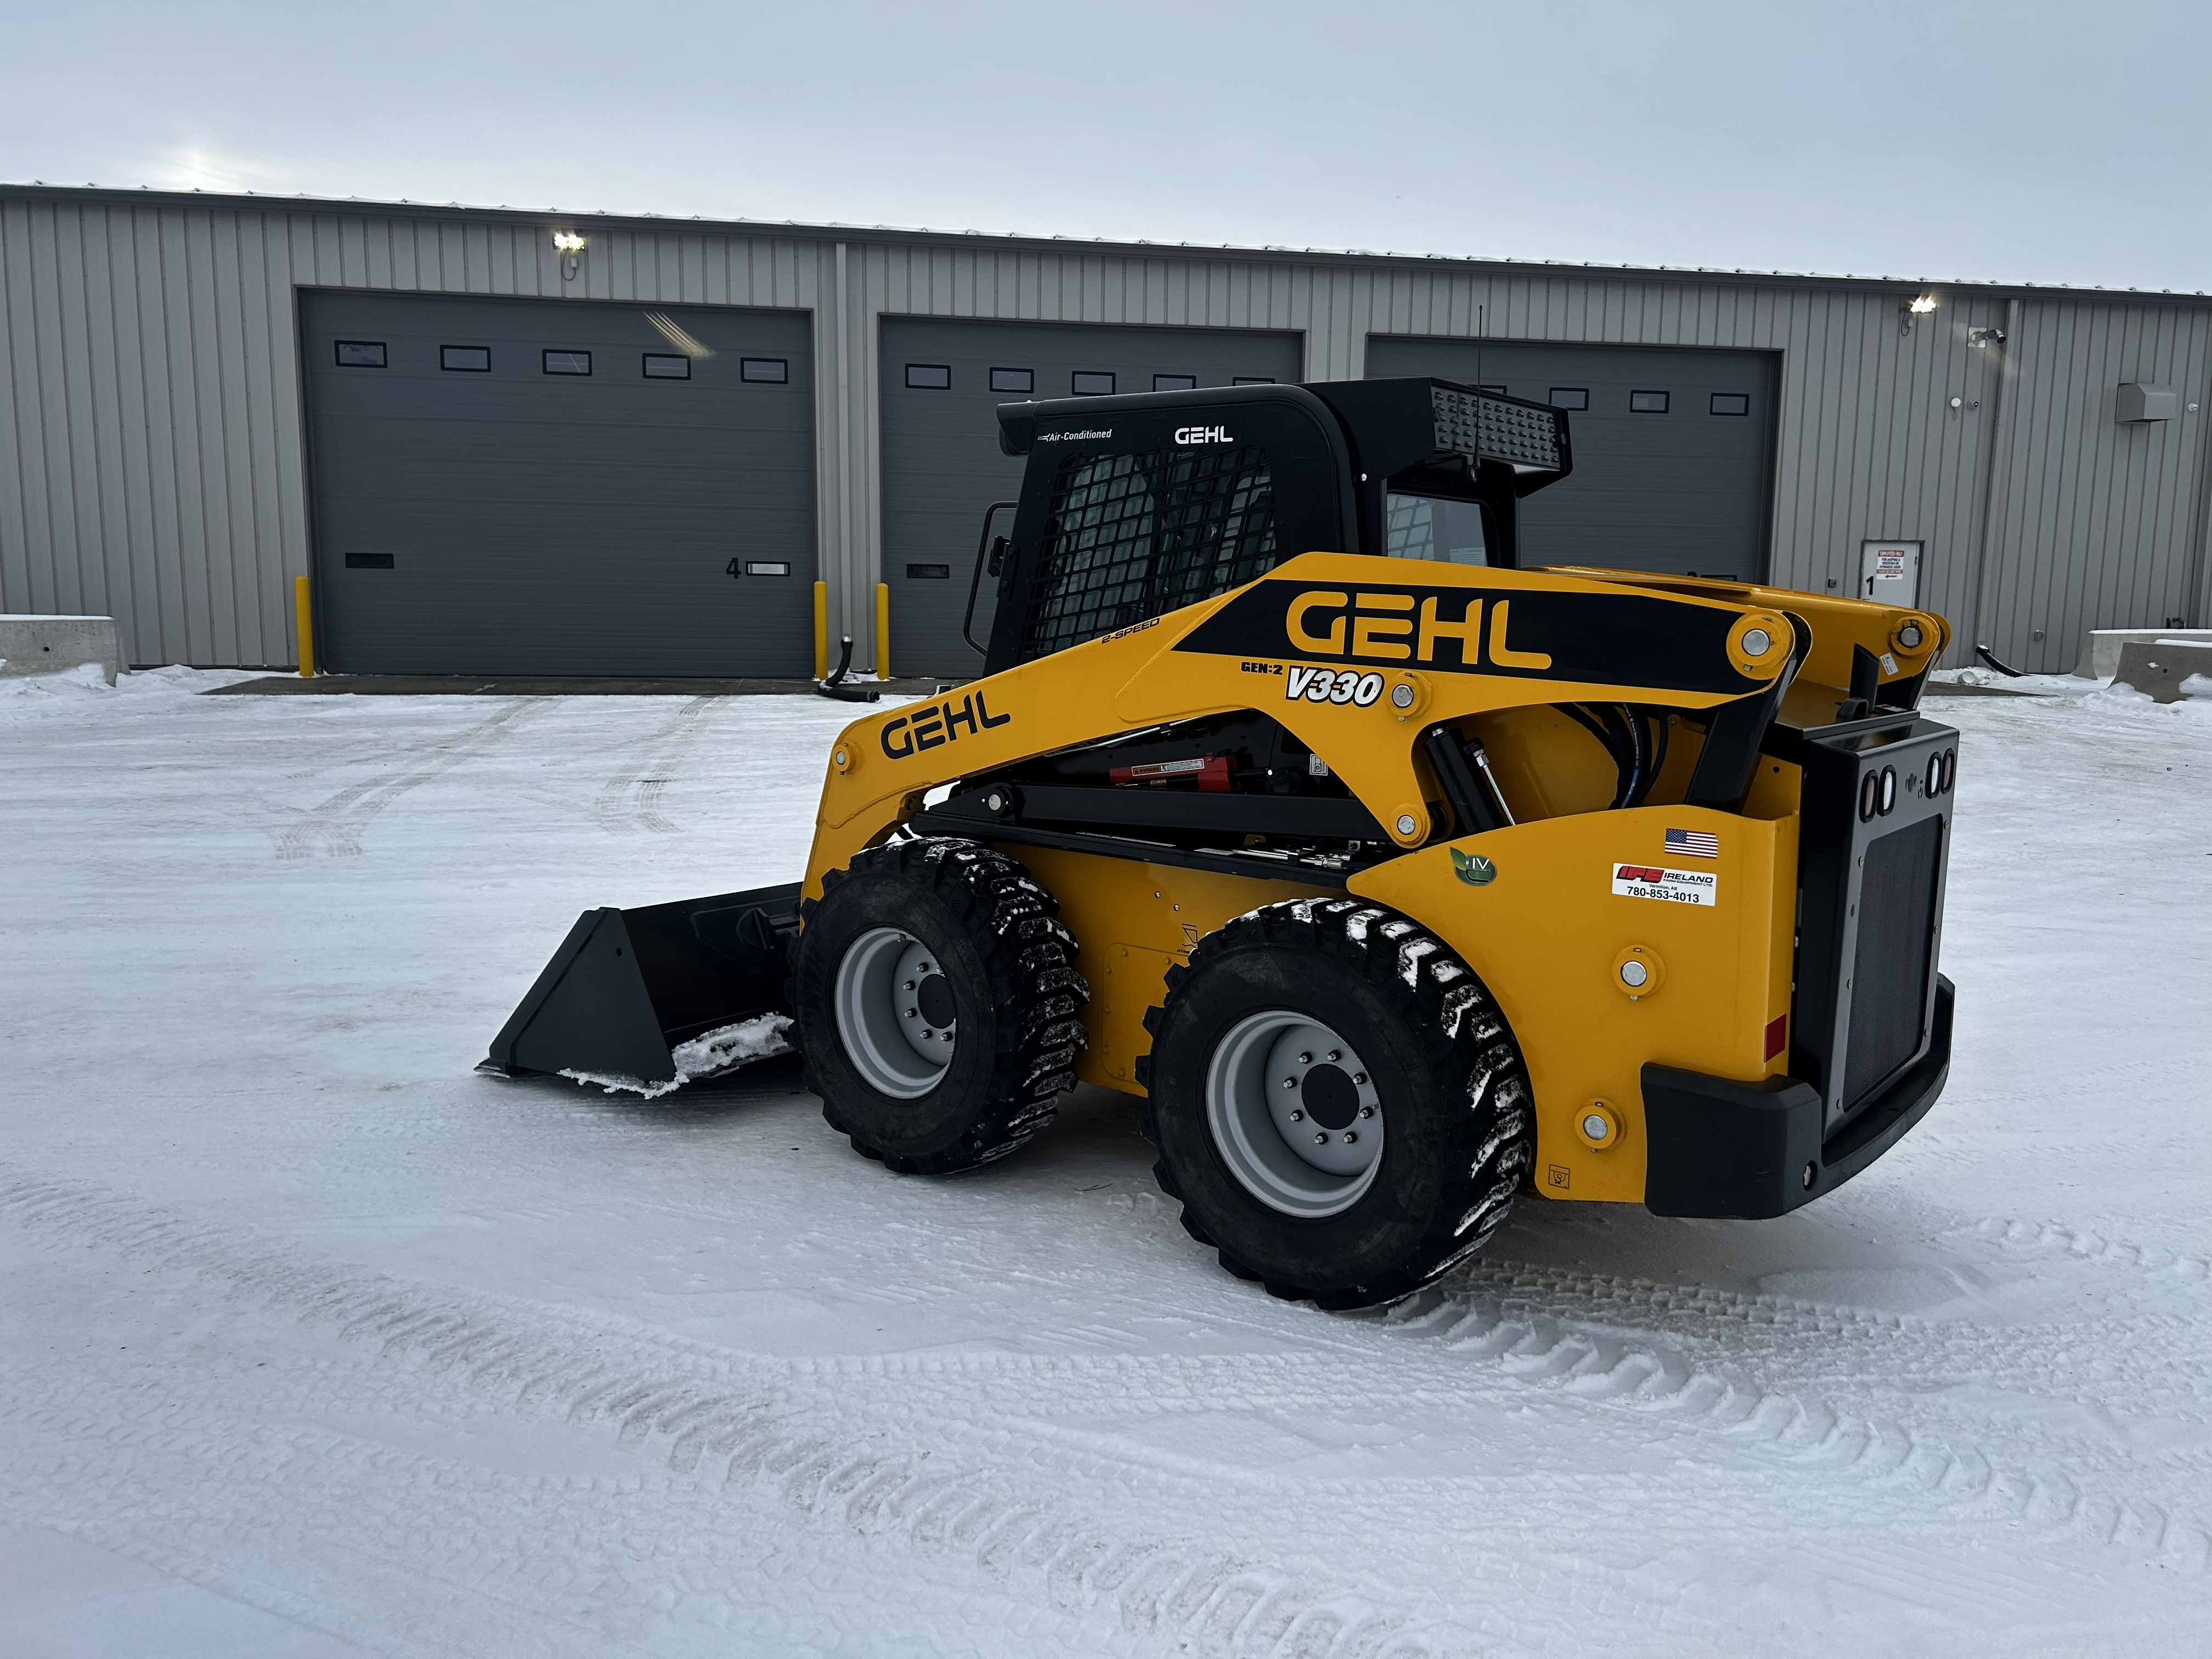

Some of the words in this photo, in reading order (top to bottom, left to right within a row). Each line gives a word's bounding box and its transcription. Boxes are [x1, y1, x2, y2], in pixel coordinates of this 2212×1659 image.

[1048, 428, 1113, 442] Air-Conditioned
[1175, 426, 1233, 444] GEHL
[726, 557, 741, 579] 4
[1866, 576, 1874, 595] 1
[1102, 618, 1160, 644] 2-SPEED
[1286, 590, 1552, 670] GEHL
[1241, 662, 1283, 675] GEN:2
[1285, 665, 1385, 708] V330
[881, 690, 1011, 759] GEHL
[1472, 857, 1490, 869] IV
[1664, 872, 1713, 883] IRELAND
[1627, 886, 1700, 903] 780-853-4013
